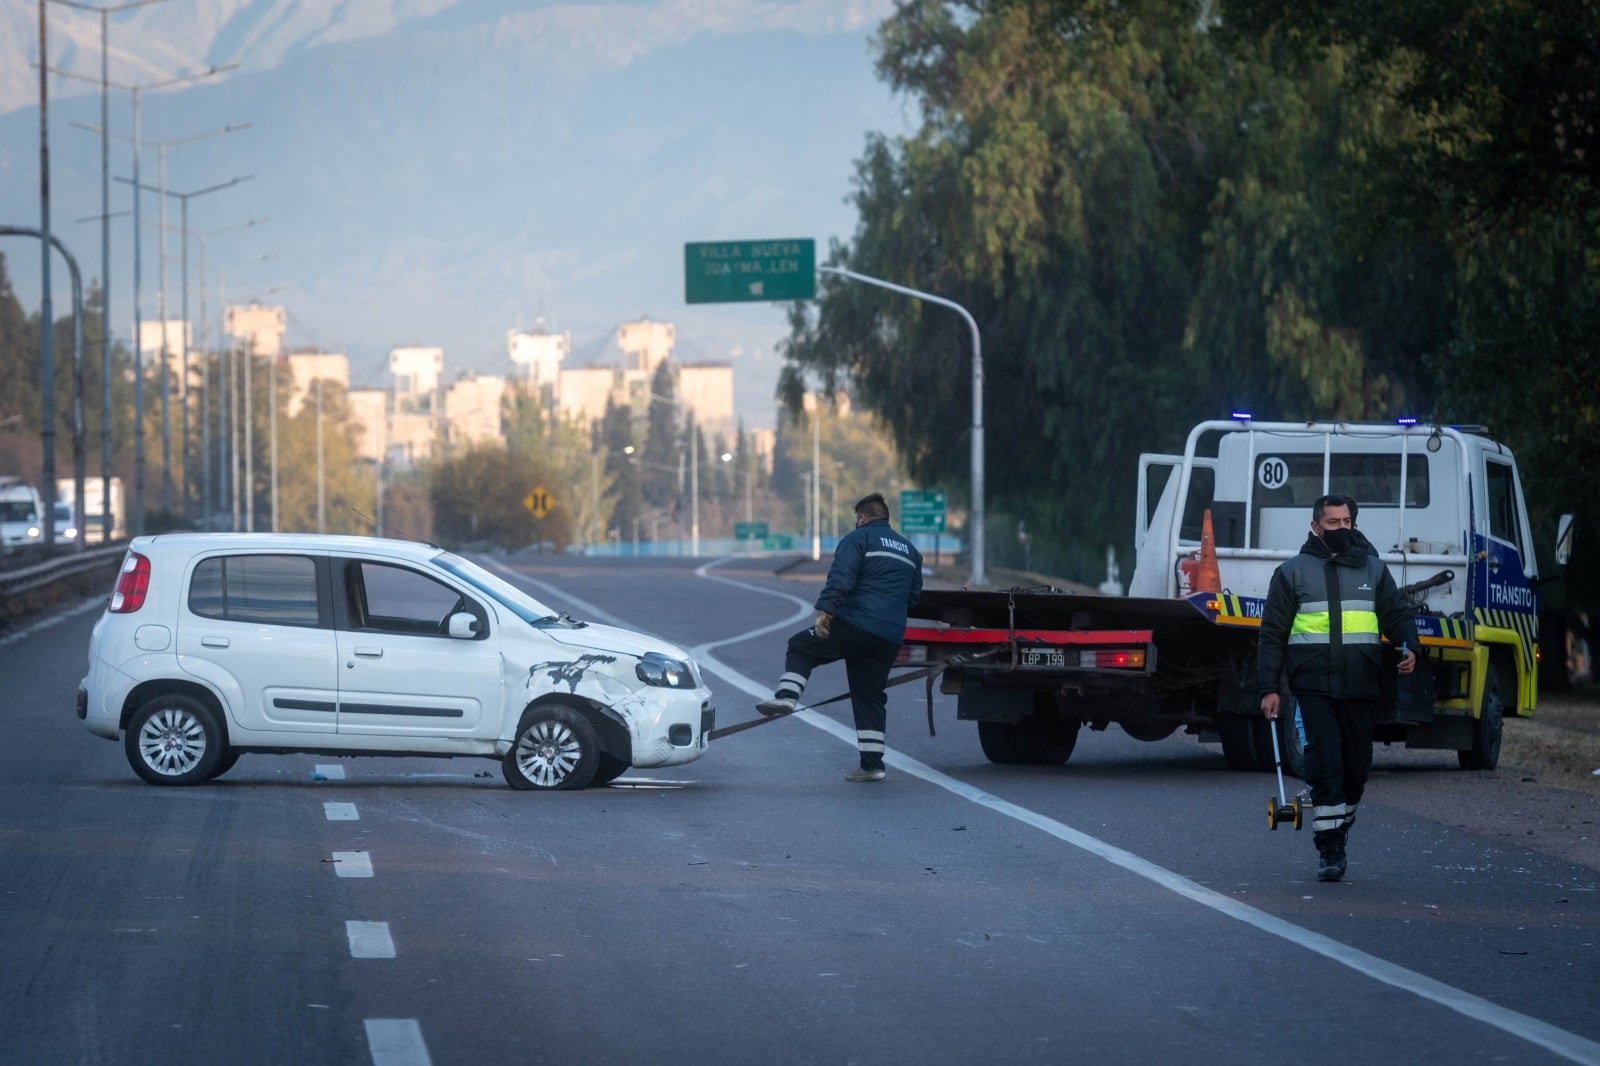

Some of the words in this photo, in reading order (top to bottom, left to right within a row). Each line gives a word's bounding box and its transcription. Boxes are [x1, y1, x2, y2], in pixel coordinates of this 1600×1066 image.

[699, 245, 741, 258] VILLA
[751, 243, 800, 257] NUEVA
[1263, 462, 1284, 484] 80
[1490, 580, 1532, 607] TRÁNSITO
[1046, 653, 1063, 666] 199
